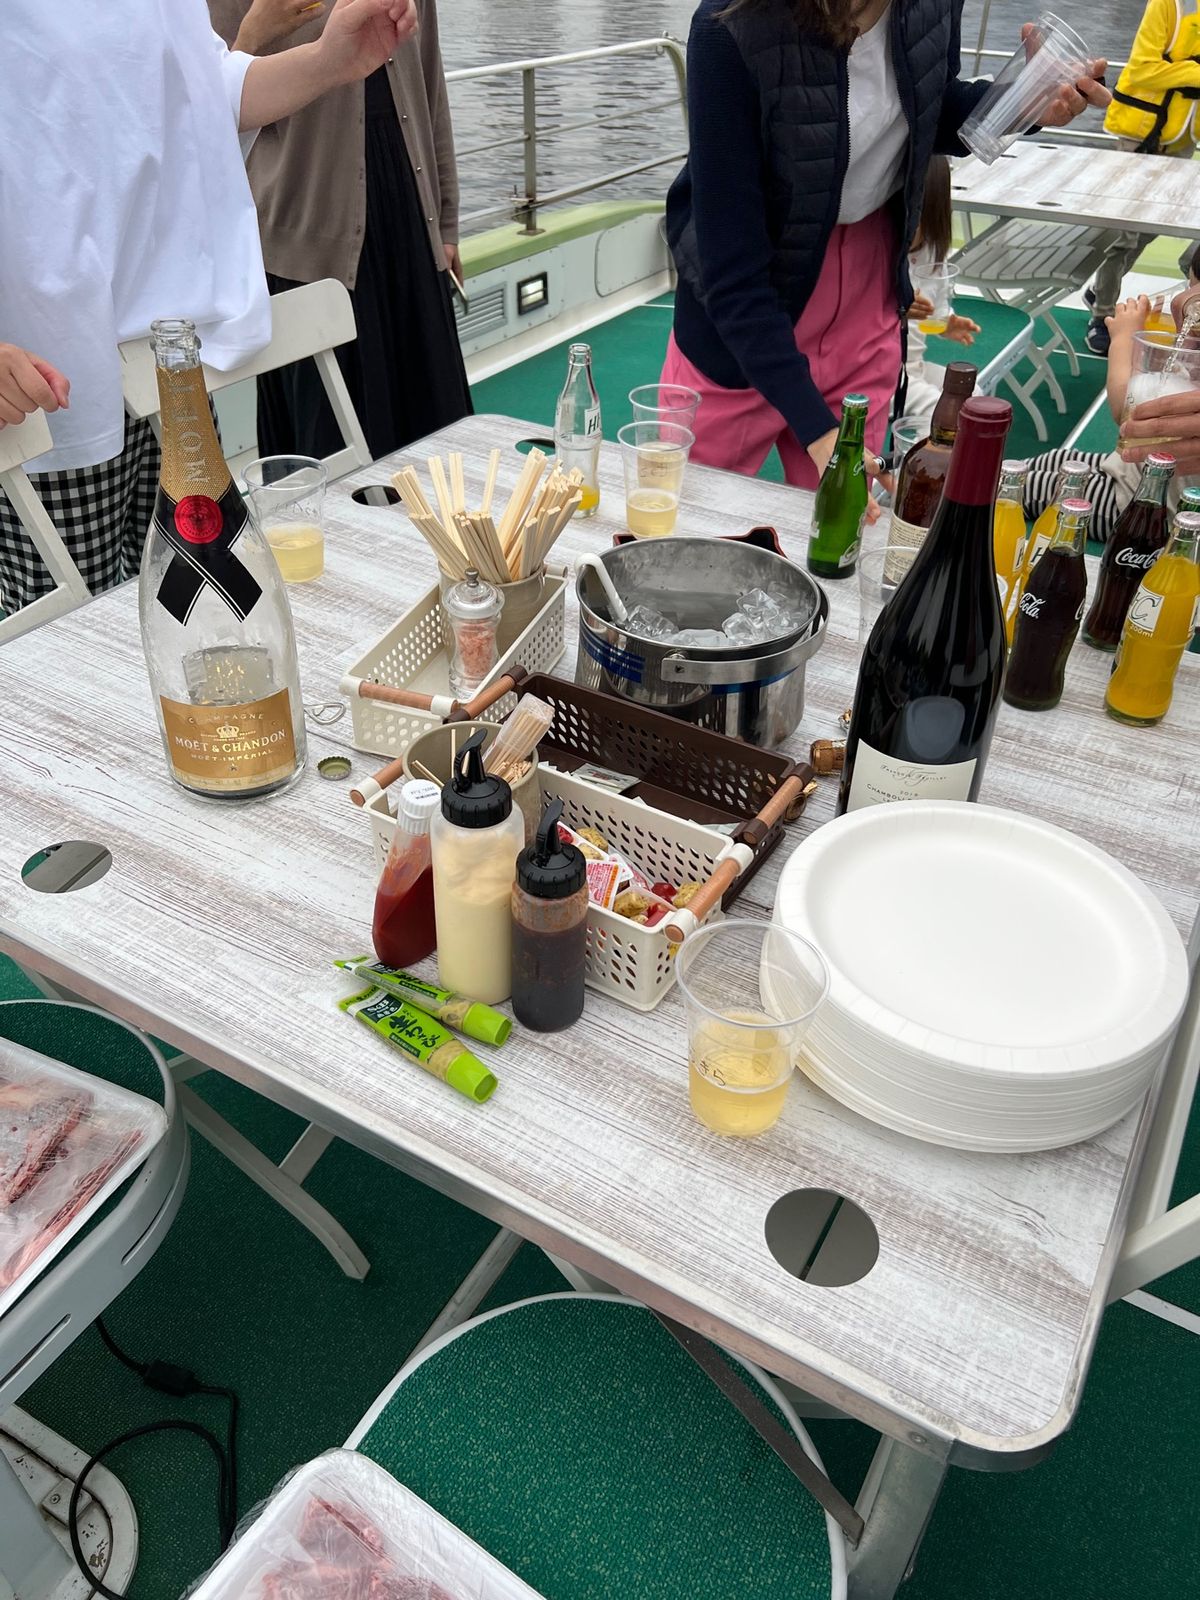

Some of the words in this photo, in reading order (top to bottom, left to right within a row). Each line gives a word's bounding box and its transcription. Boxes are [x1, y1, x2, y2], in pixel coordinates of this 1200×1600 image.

[1128, 623, 1154, 638] 200ml
[211, 744, 220, 753] &
[222, 728, 286, 753] CHANDON
[388, 1014, 441, 1048] 生わさび
